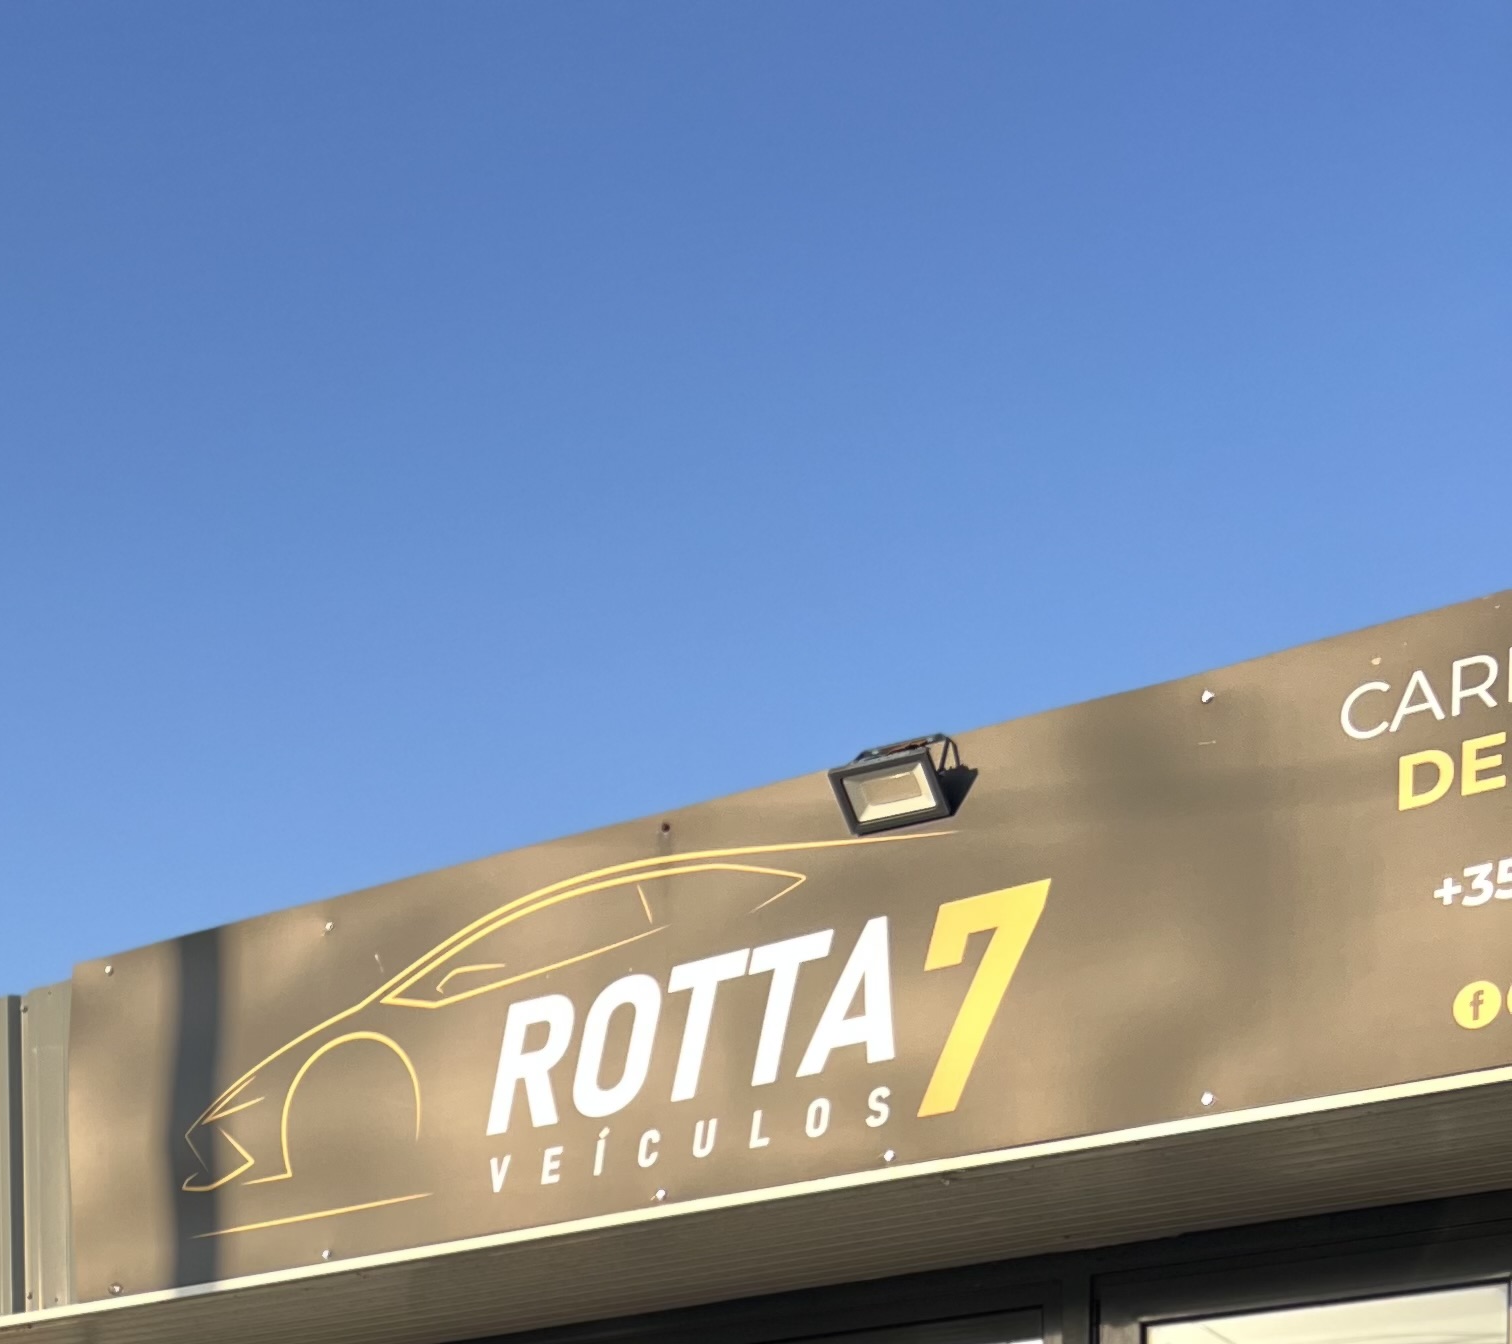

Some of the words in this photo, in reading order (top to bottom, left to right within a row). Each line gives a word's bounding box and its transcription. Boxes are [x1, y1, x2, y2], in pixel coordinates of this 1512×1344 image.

[1340, 646, 1512, 740] CAR
[1398, 732, 1506, 811] DE
[486, 916, 895, 1136] ROTTA
[489, 1086, 891, 1194] VEÍCULOS
